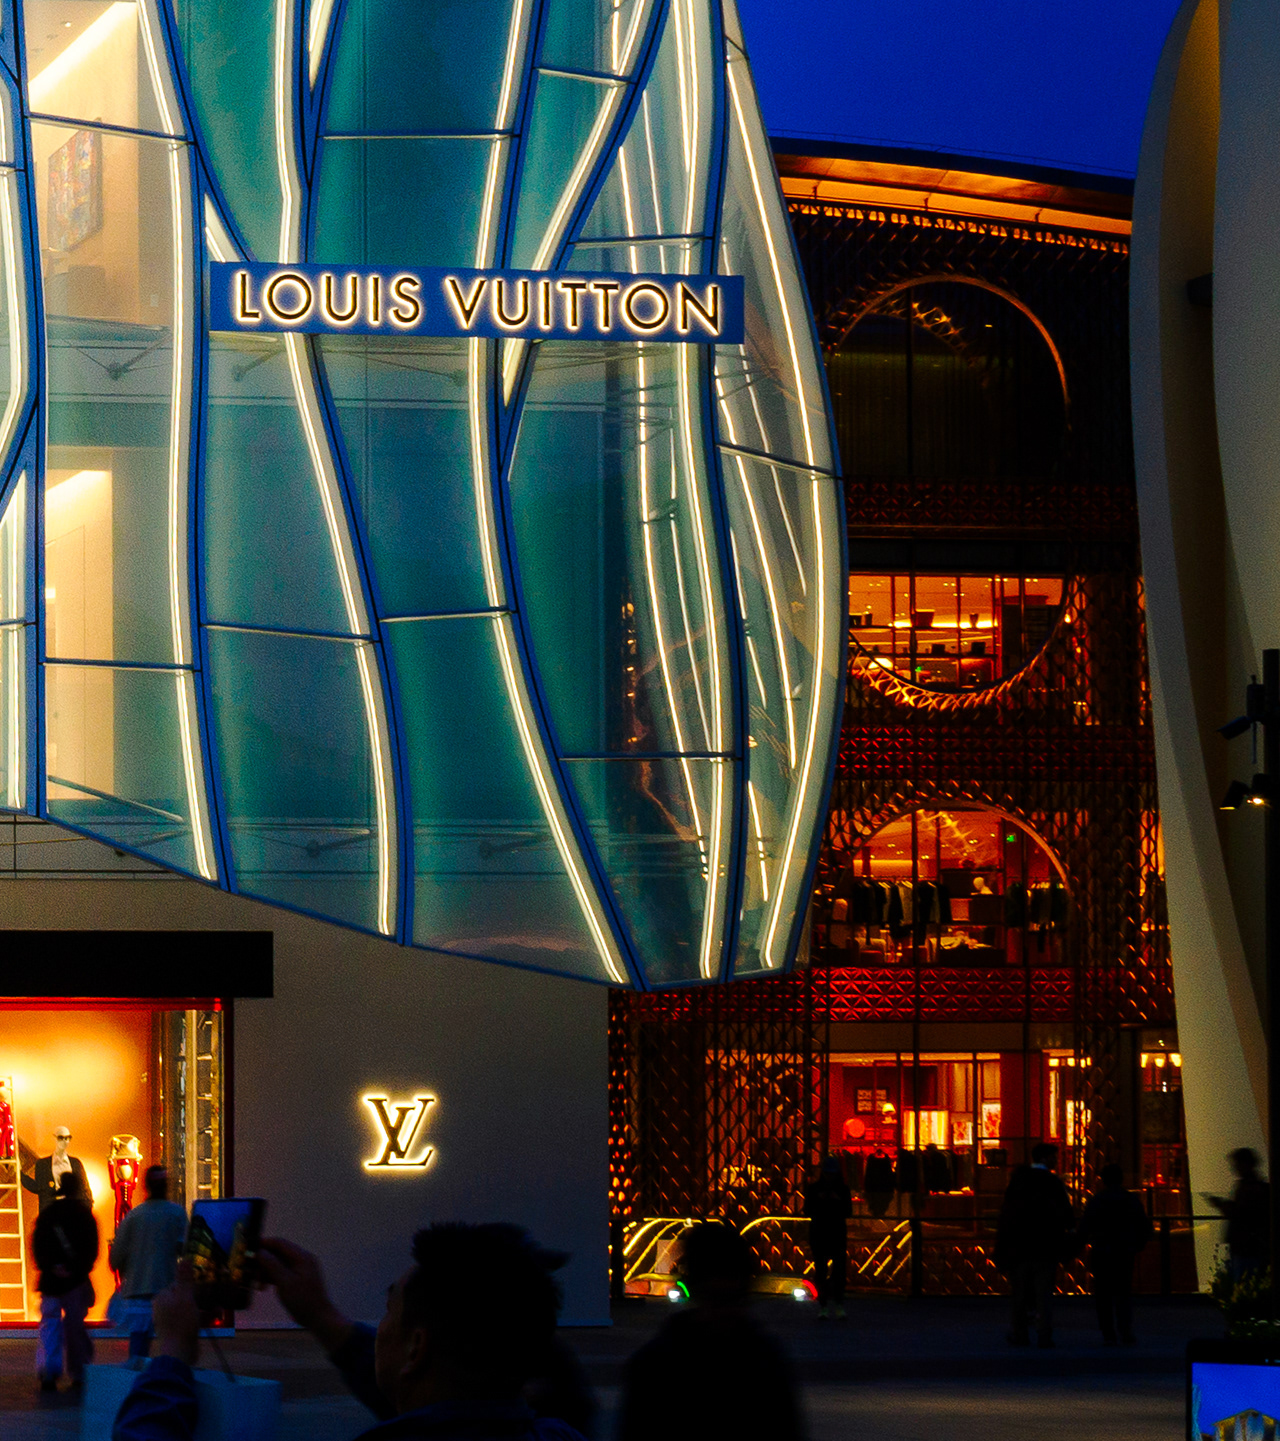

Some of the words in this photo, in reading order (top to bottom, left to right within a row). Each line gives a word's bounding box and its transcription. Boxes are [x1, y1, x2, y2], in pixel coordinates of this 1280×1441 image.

[236, 270, 422, 327] LOUIS
[444, 276, 722, 336] VUITTON
[364, 1095, 436, 1170] LV
